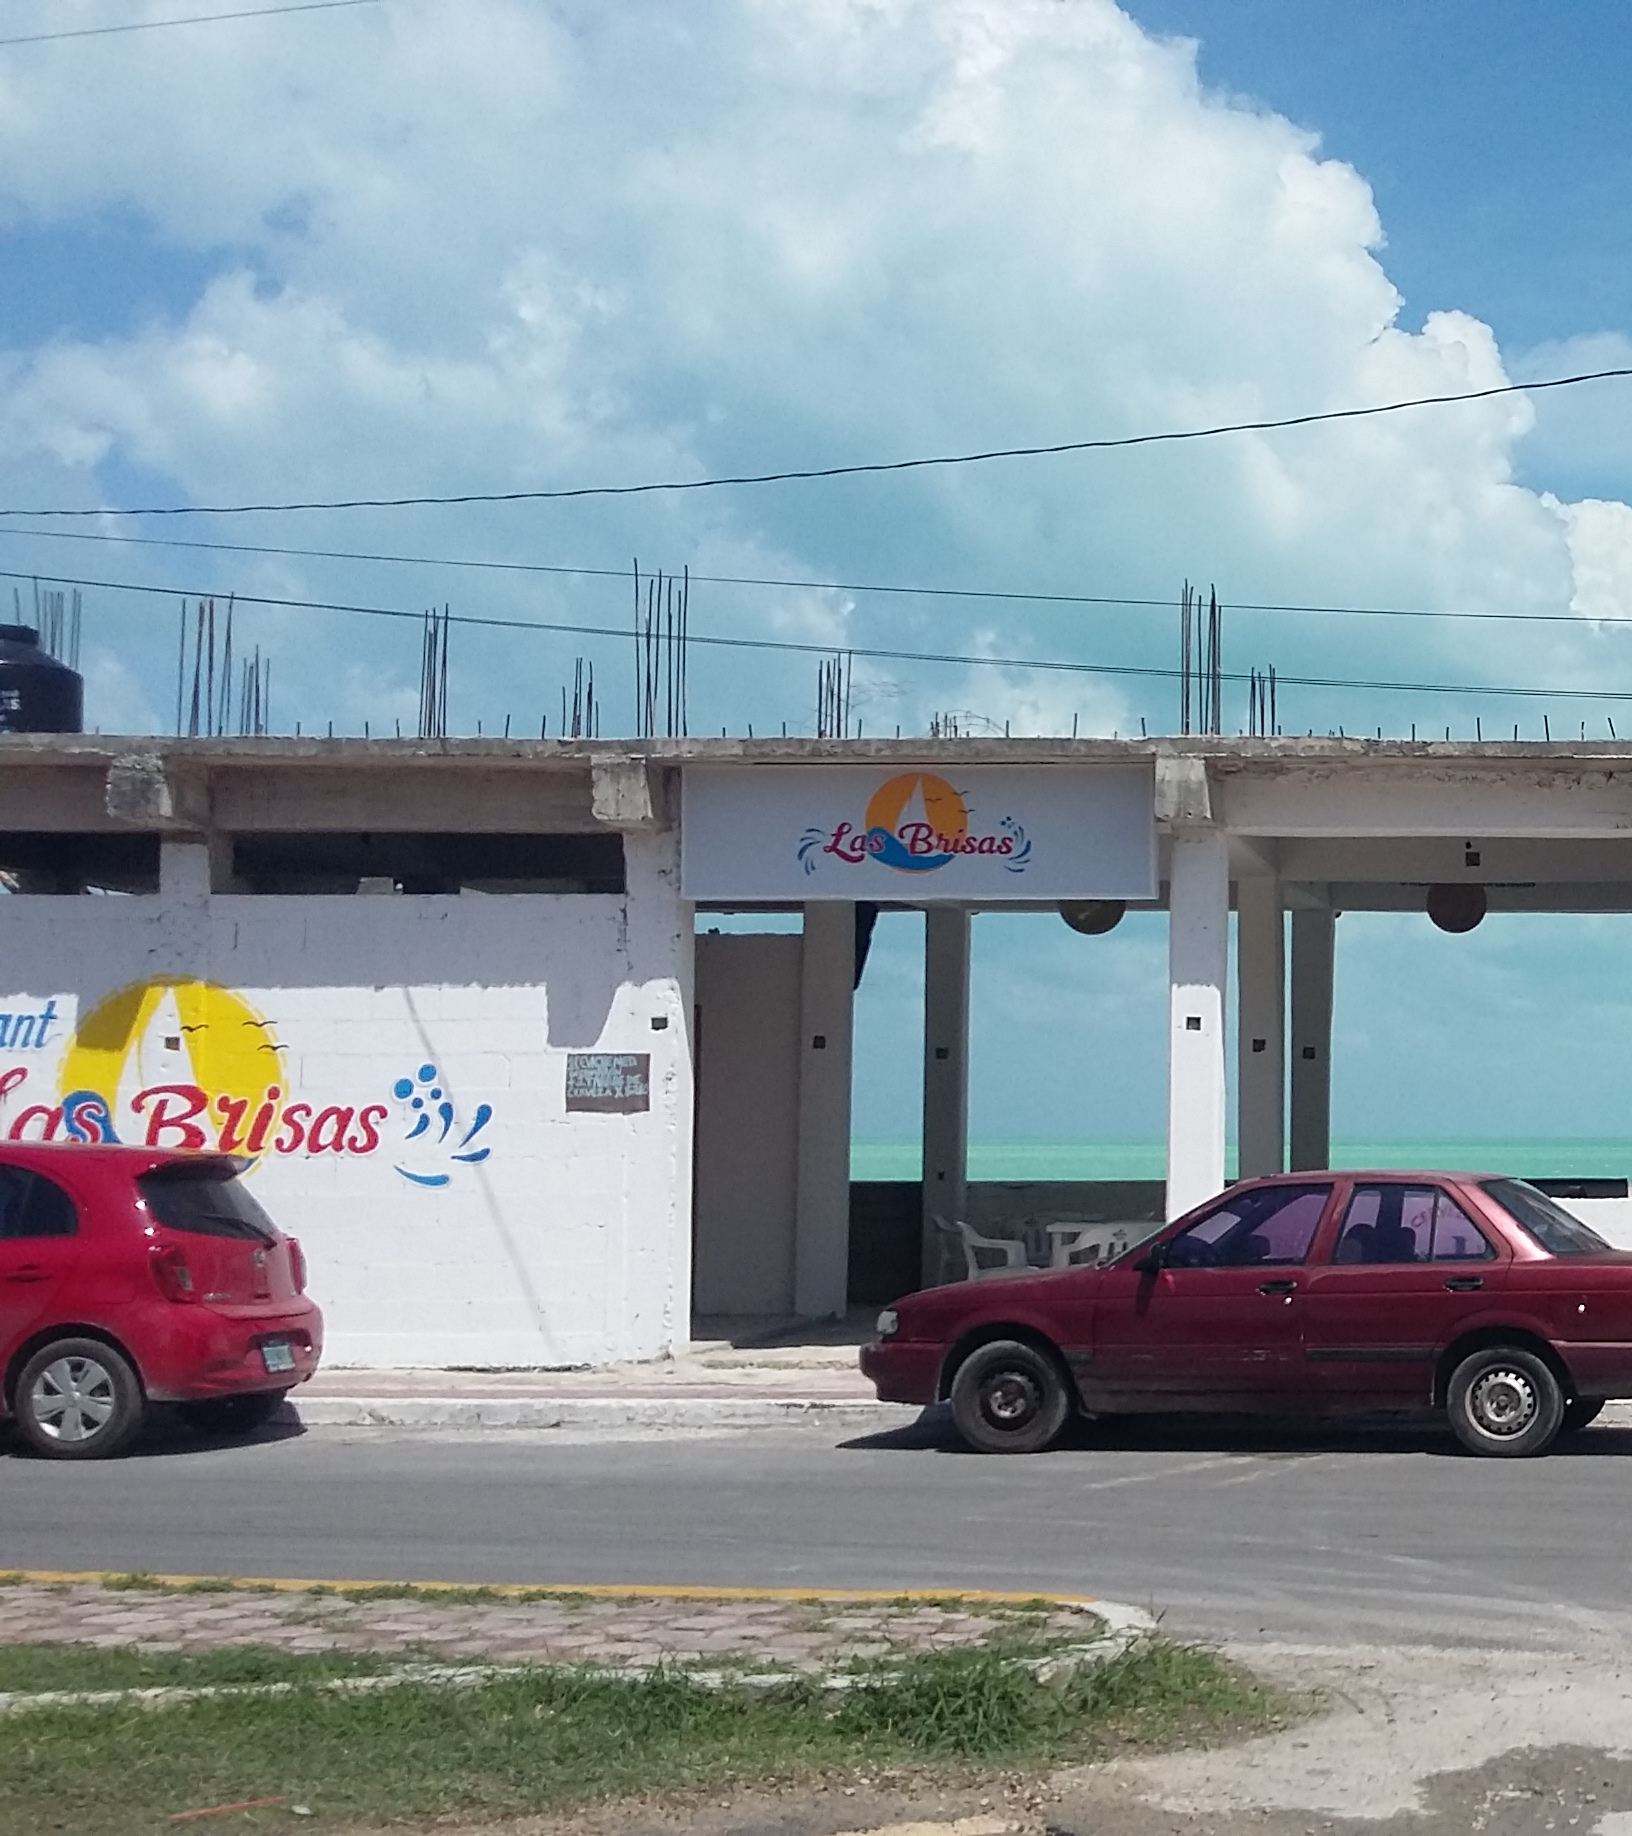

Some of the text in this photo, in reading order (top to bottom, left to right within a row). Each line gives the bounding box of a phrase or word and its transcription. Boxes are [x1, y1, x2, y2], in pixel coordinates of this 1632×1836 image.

[824, 822, 1015, 863] Las Brisas
[131, 1085, 388, 1154] Brisas
